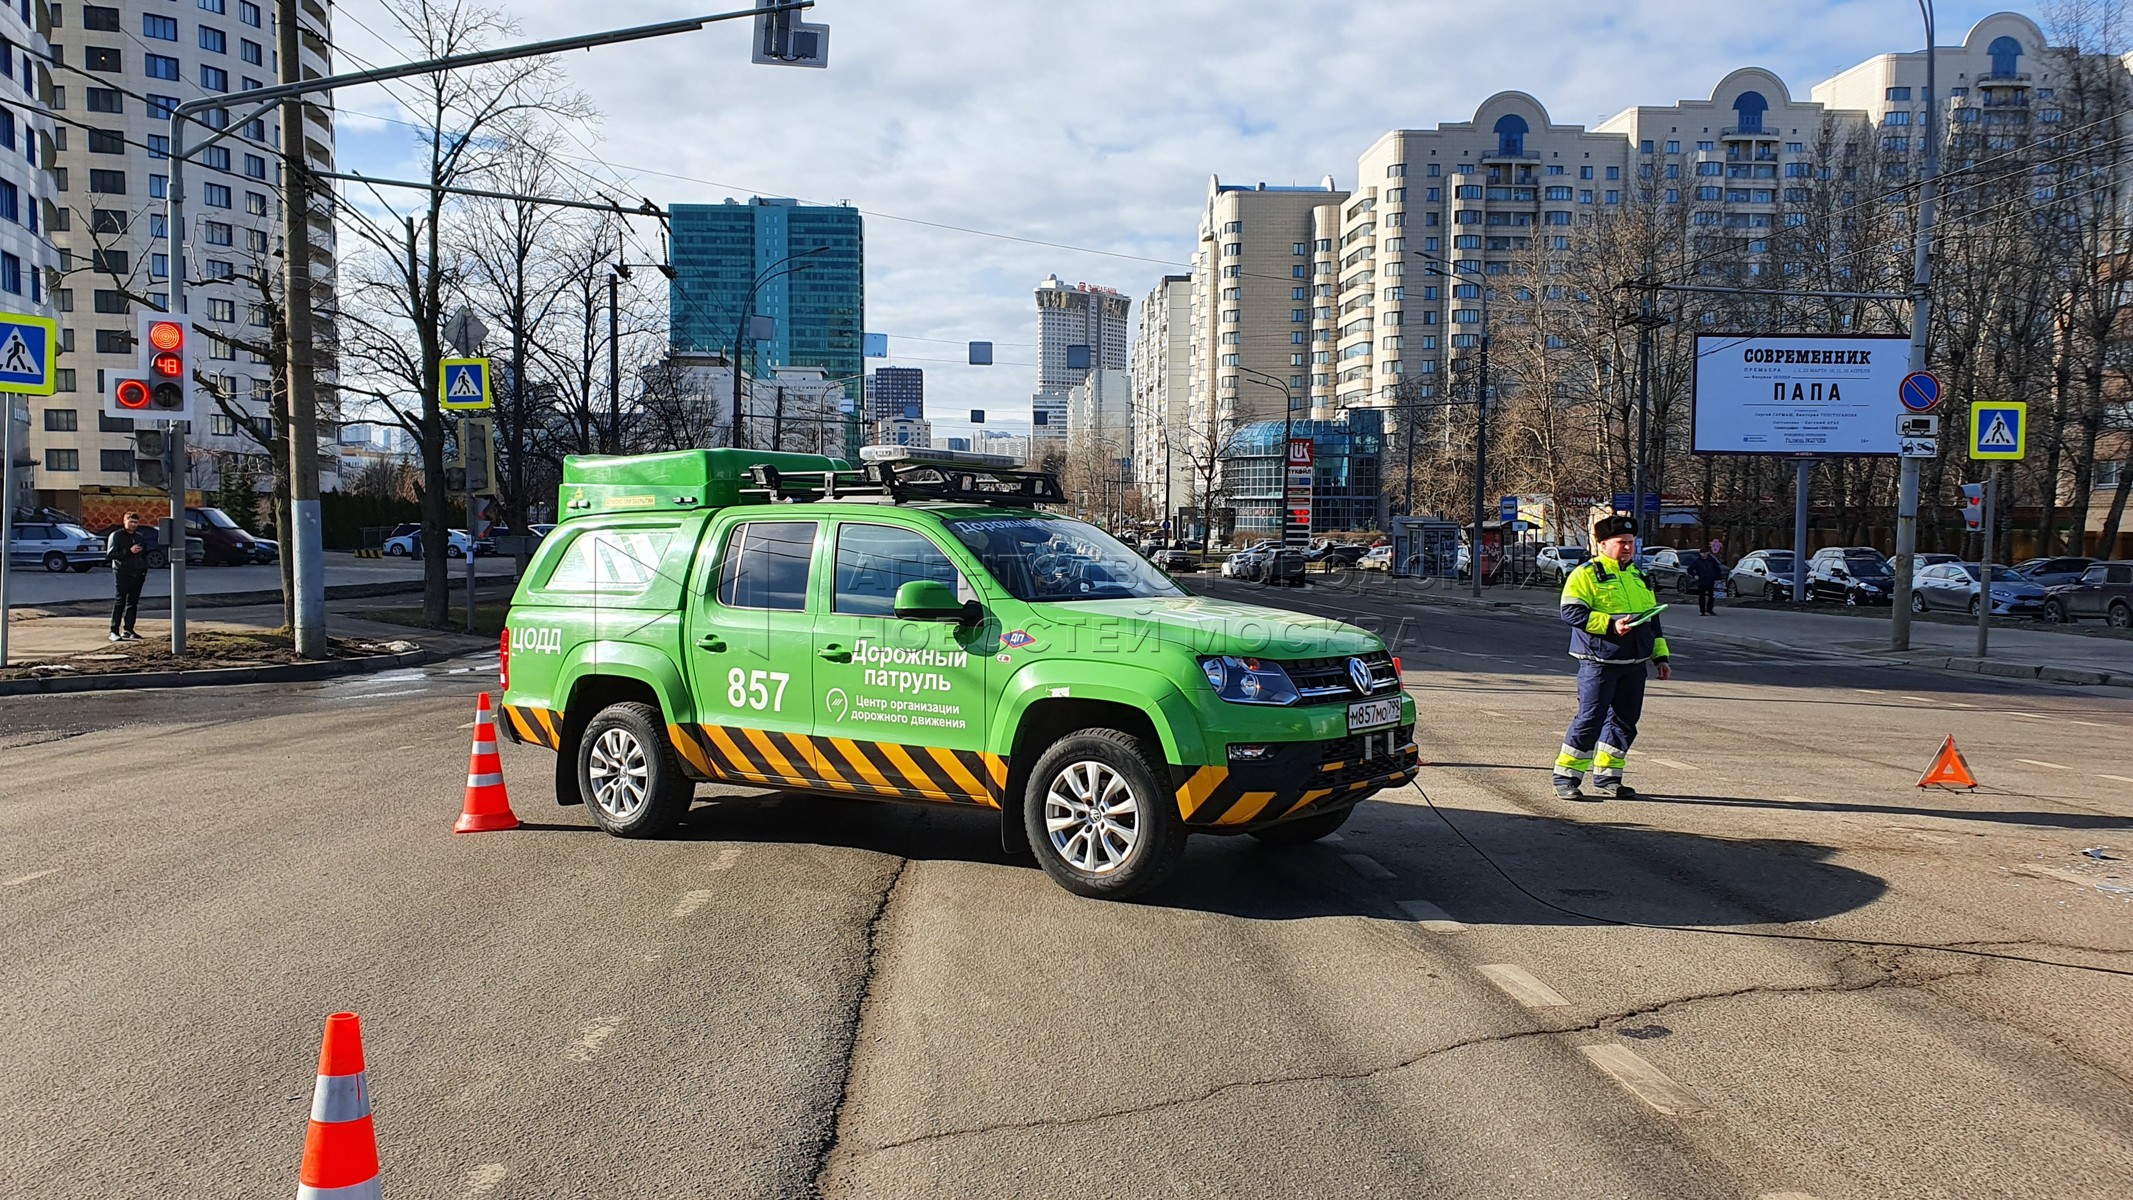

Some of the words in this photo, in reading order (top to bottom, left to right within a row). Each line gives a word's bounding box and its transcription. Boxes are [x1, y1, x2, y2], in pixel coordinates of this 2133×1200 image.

[157, 358, 177, 374] 48
[1744, 348, 1872, 365] СОВРЕМЕННИК
[1773, 382, 1841, 401] ПАПА
[512, 627, 562, 656] ЦОДД
[851, 640, 968, 669] Дорожный
[727, 667, 790, 713] 857
[864, 668, 952, 694] патруль
[855, 694, 887, 713] Центр
[890, 699, 960, 714] организации
[850, 710, 908, 726] дорожного
[910, 715, 967, 729] движения
